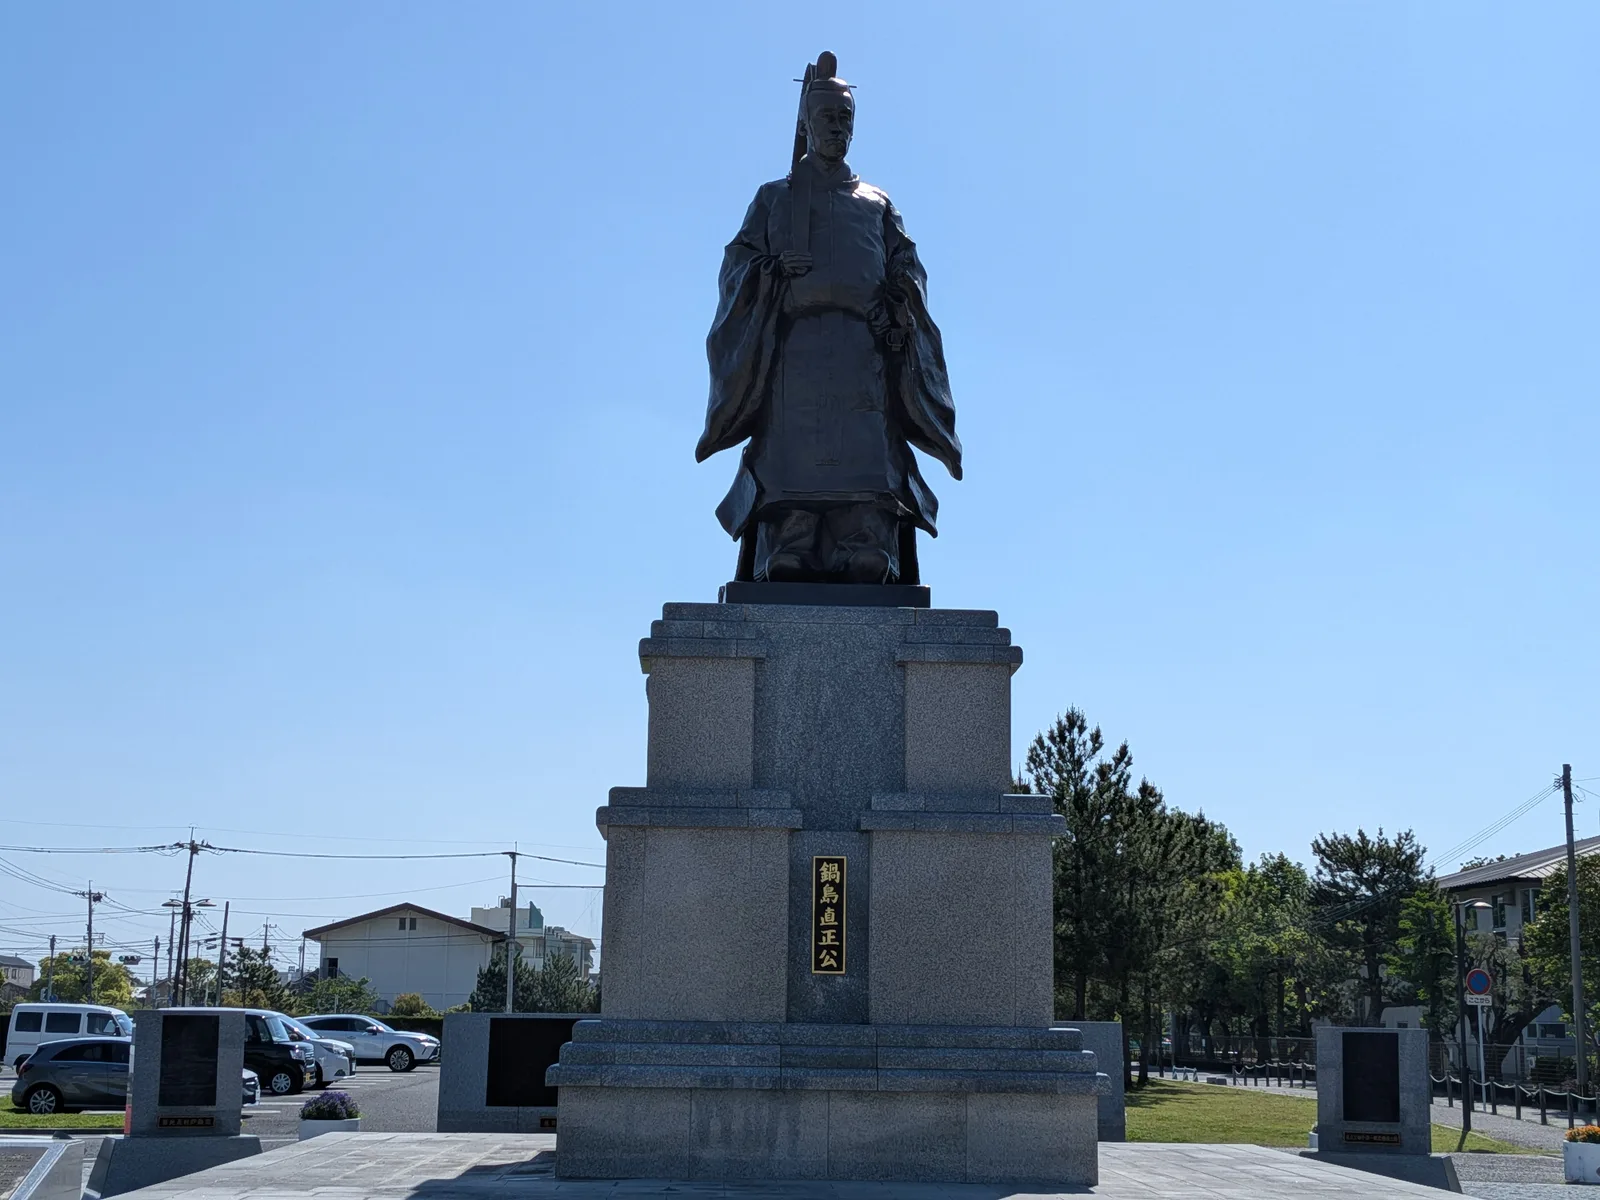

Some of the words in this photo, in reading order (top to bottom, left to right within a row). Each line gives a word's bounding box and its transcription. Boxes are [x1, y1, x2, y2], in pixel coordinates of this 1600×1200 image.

[818, 861, 840, 968] 鍋島直正公
